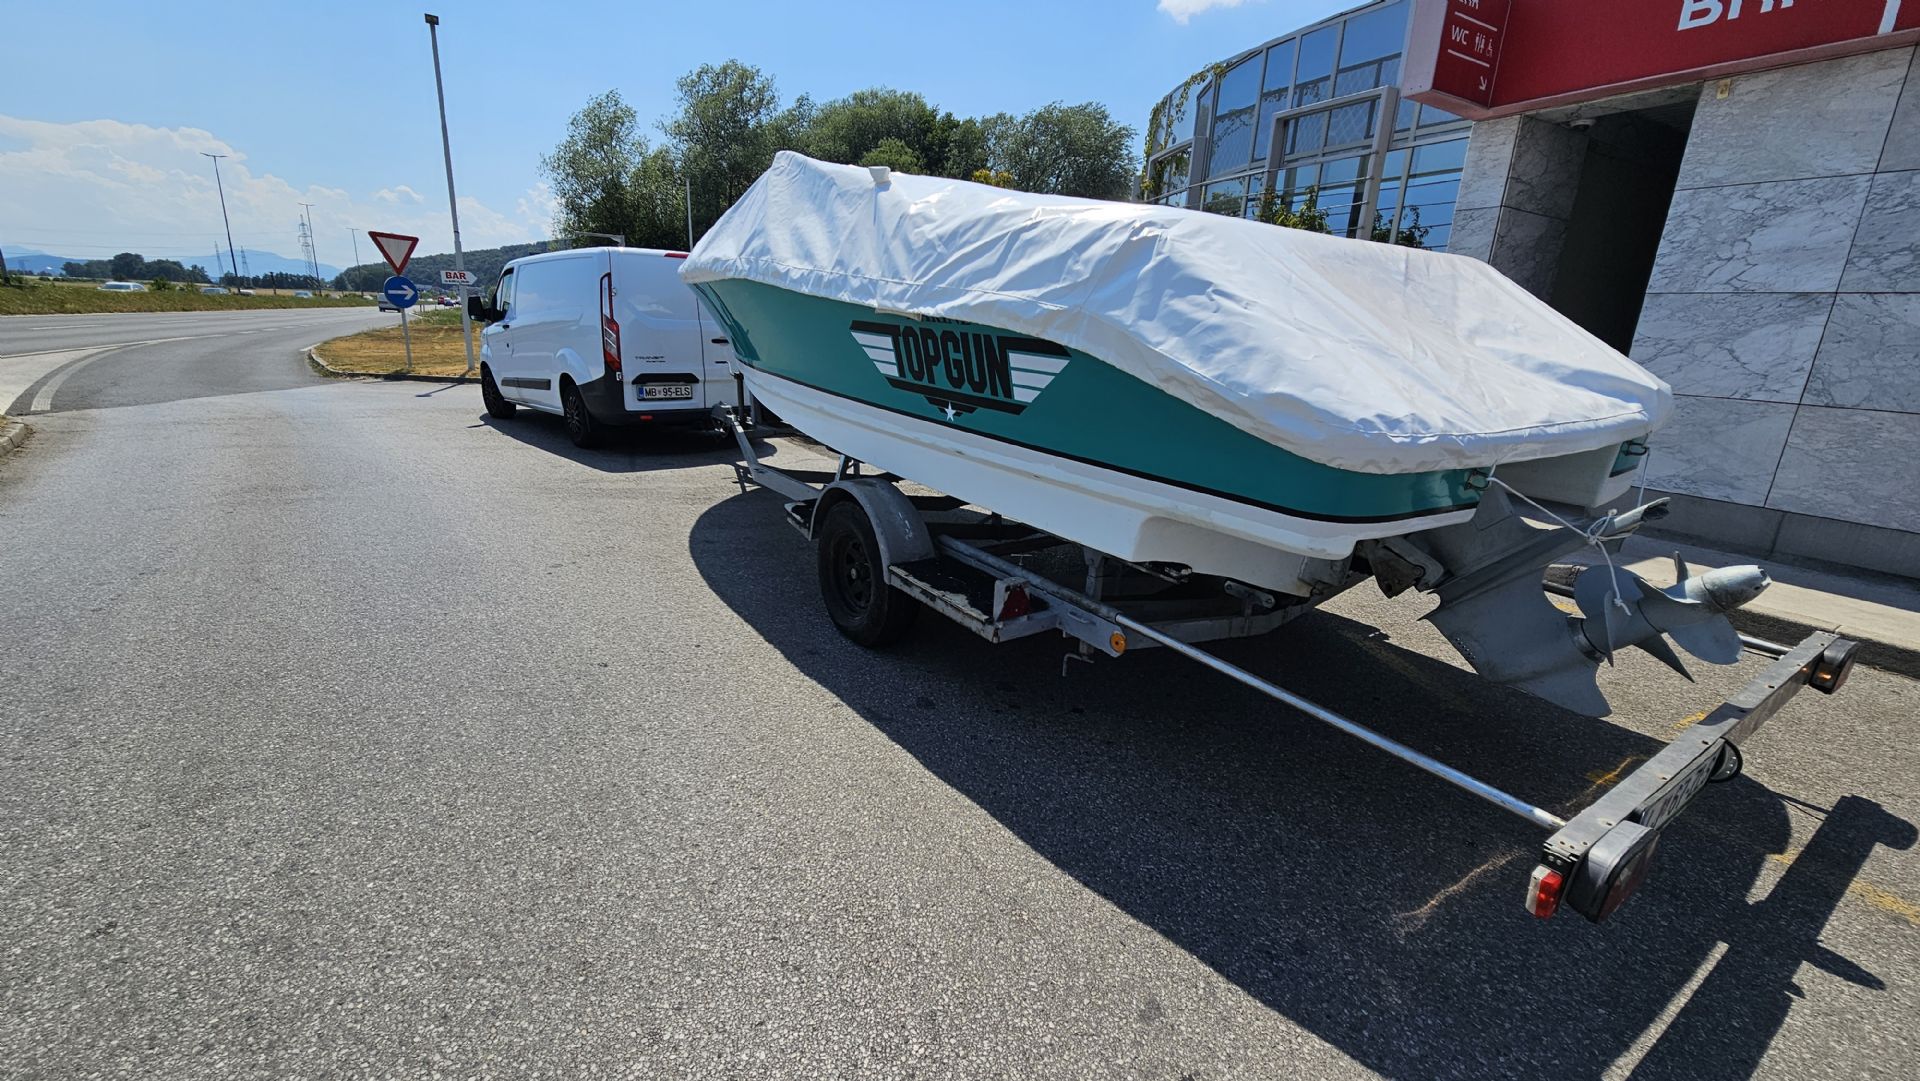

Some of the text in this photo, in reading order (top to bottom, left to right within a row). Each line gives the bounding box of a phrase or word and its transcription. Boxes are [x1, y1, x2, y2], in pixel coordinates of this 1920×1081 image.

[1451, 24, 1469, 45] WC
[445, 272, 467, 280] BAR
[645, 387, 690, 397] MB 95-ELS
